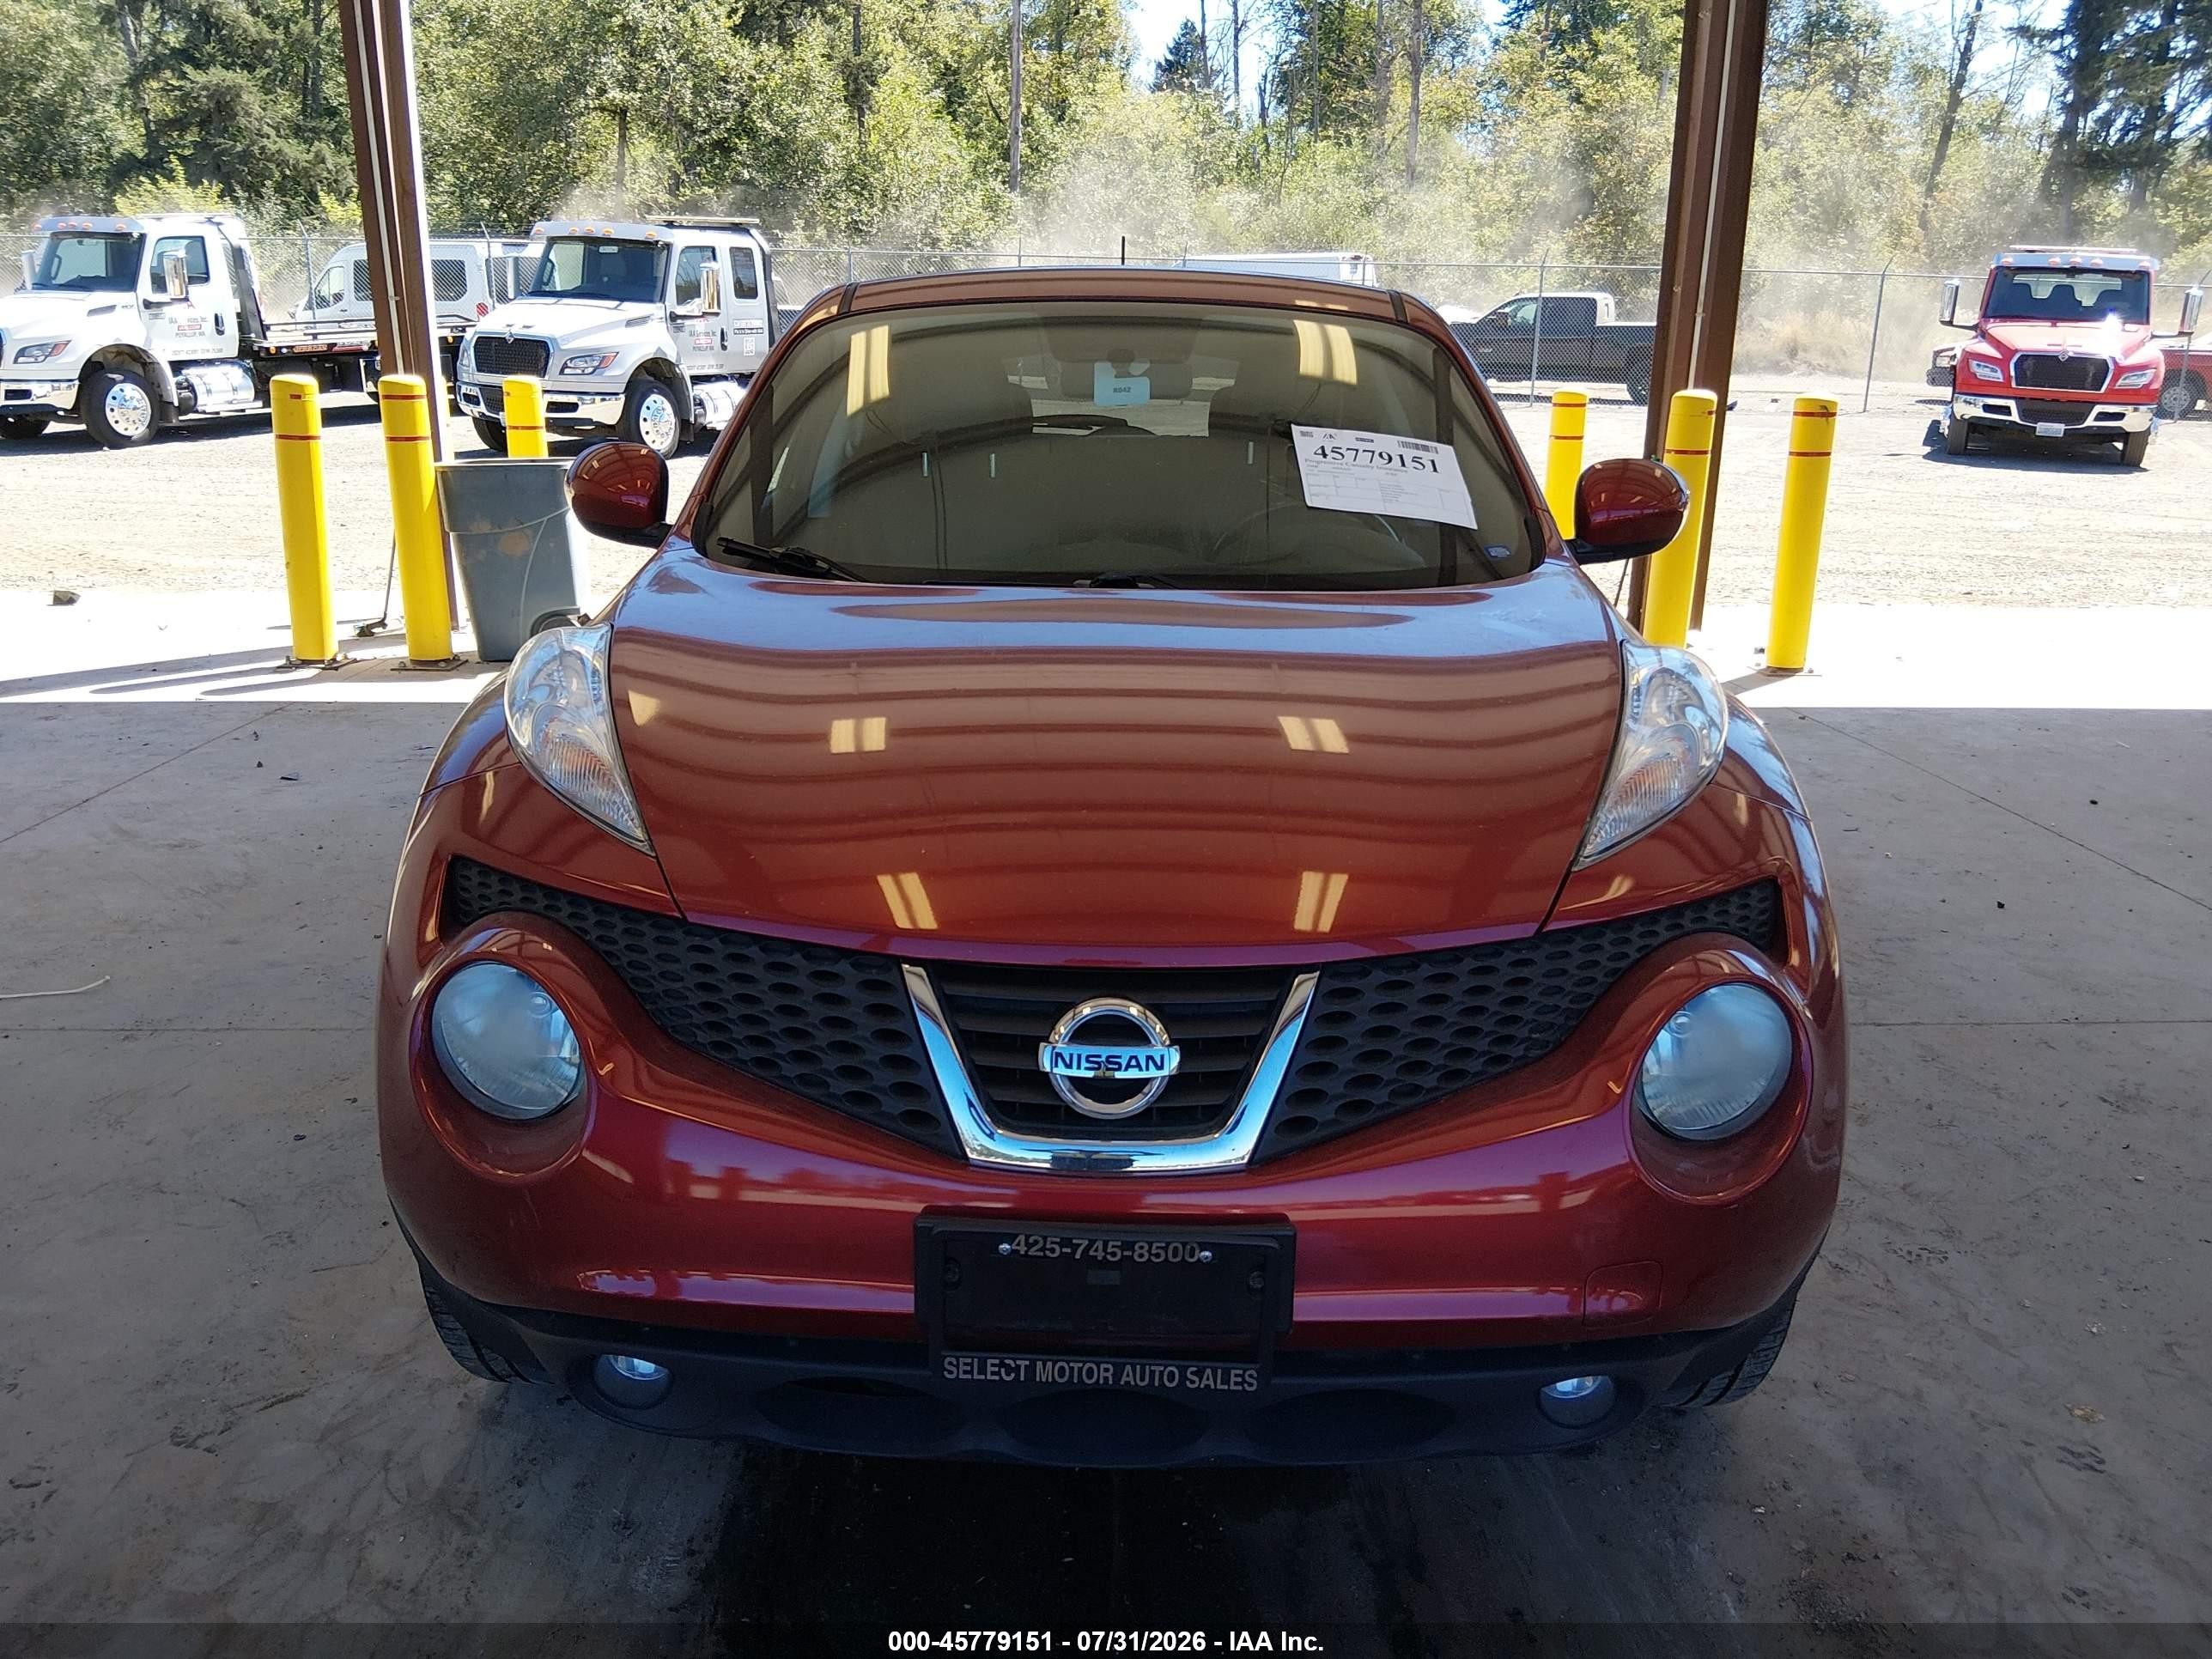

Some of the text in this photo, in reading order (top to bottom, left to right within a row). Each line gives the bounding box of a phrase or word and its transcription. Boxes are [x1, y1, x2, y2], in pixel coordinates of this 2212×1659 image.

[1313, 445, 1440, 473] 45779151
[1054, 1051, 1165, 1073] NISSAN
[1011, 1234, 1200, 1263] 425-745-8500
[944, 1357, 1258, 1392] SELECT MOTOR AUTO SALES
